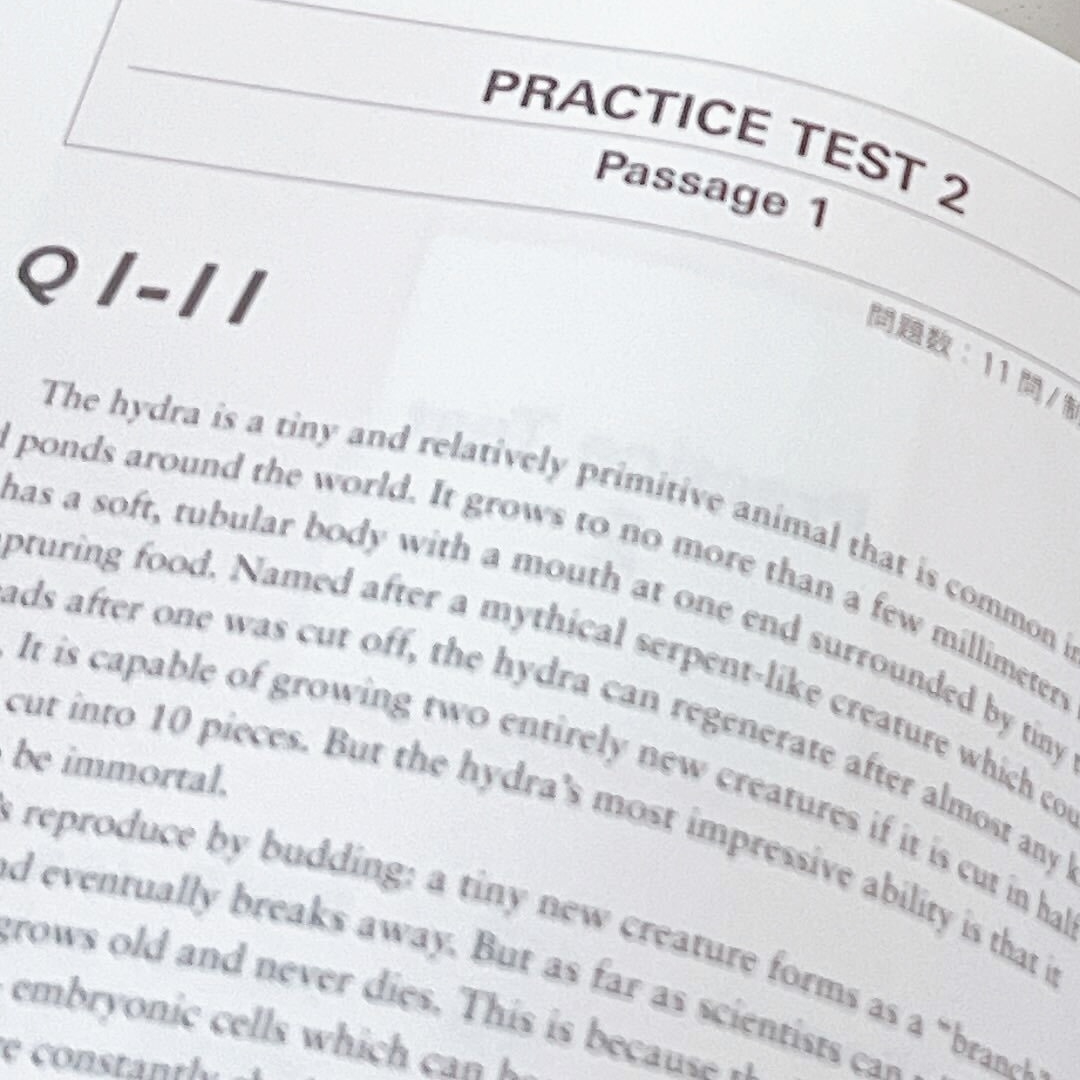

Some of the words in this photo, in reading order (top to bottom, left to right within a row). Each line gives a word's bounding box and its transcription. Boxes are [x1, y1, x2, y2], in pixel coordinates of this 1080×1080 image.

[481, 68, 773, 146] PRACTICE
[792, 118, 927, 194] TEST
[938, 172, 971, 216] 2
[596, 149, 789, 218] Passage
[810, 196, 830, 229] 1
[42, 378, 101, 412] The
[108, 387, 201, 426] hydra
[211, 402, 237, 430] is
[245, 413, 265, 434] a
[274, 411, 340, 448] tiny
[347, 423, 412, 452] and
[417, 430, 568, 483] relatively
[575, 461, 726, 516] primitive
[731, 500, 841, 551] animal
[848, 532, 910, 578] that
[915, 555, 940, 591] is
[945, 577, 1058, 650] common
[62, 490, 82, 511] a
[93, 489, 162, 524] soft,
[174, 499, 296, 537] tubular
[303, 510, 388, 556] body
[399, 529, 471, 563] with
[480, 546, 500, 569] a
[511, 560, 622, 594] mouth
[630, 579, 665, 604] at
[673, 589, 735, 623] one
[741, 609, 802, 645] end
[808, 628, 977, 715] surrounded
[983, 691, 1015, 737] by
[1021, 719, 1069, 769] tiny
[134, 540, 216, 580] food.
[229, 553, 355, 597] Named
[359, 573, 441, 611] after
[448, 593, 468, 616] a
[479, 602, 628, 648] mythical
[634, 631, 823, 707] serpent-like
[829, 691, 952, 757] creature
[959, 744, 1035, 801] which
[5, 692, 60, 718] cut
[68, 691, 137, 727] into
[150, 703, 193, 734] 10
[197, 711, 309, 753] pieces.
[323, 726, 385, 765] But
[394, 739, 448, 777] the
[592, 791, 679, 831] most
[686, 806, 855, 893] impressive
[862, 870, 954, 937] ability
[960, 909, 983, 944] is
[989, 926, 1040, 978] that
[1045, 953, 1063, 993] it
[61, 746, 228, 796] immortal.
[108, 923, 170, 963] old
[175, 941, 249, 975] and
[254, 956, 354, 994] never
[460, 986, 535, 1034] This
[545, 1008, 574, 1044] is
